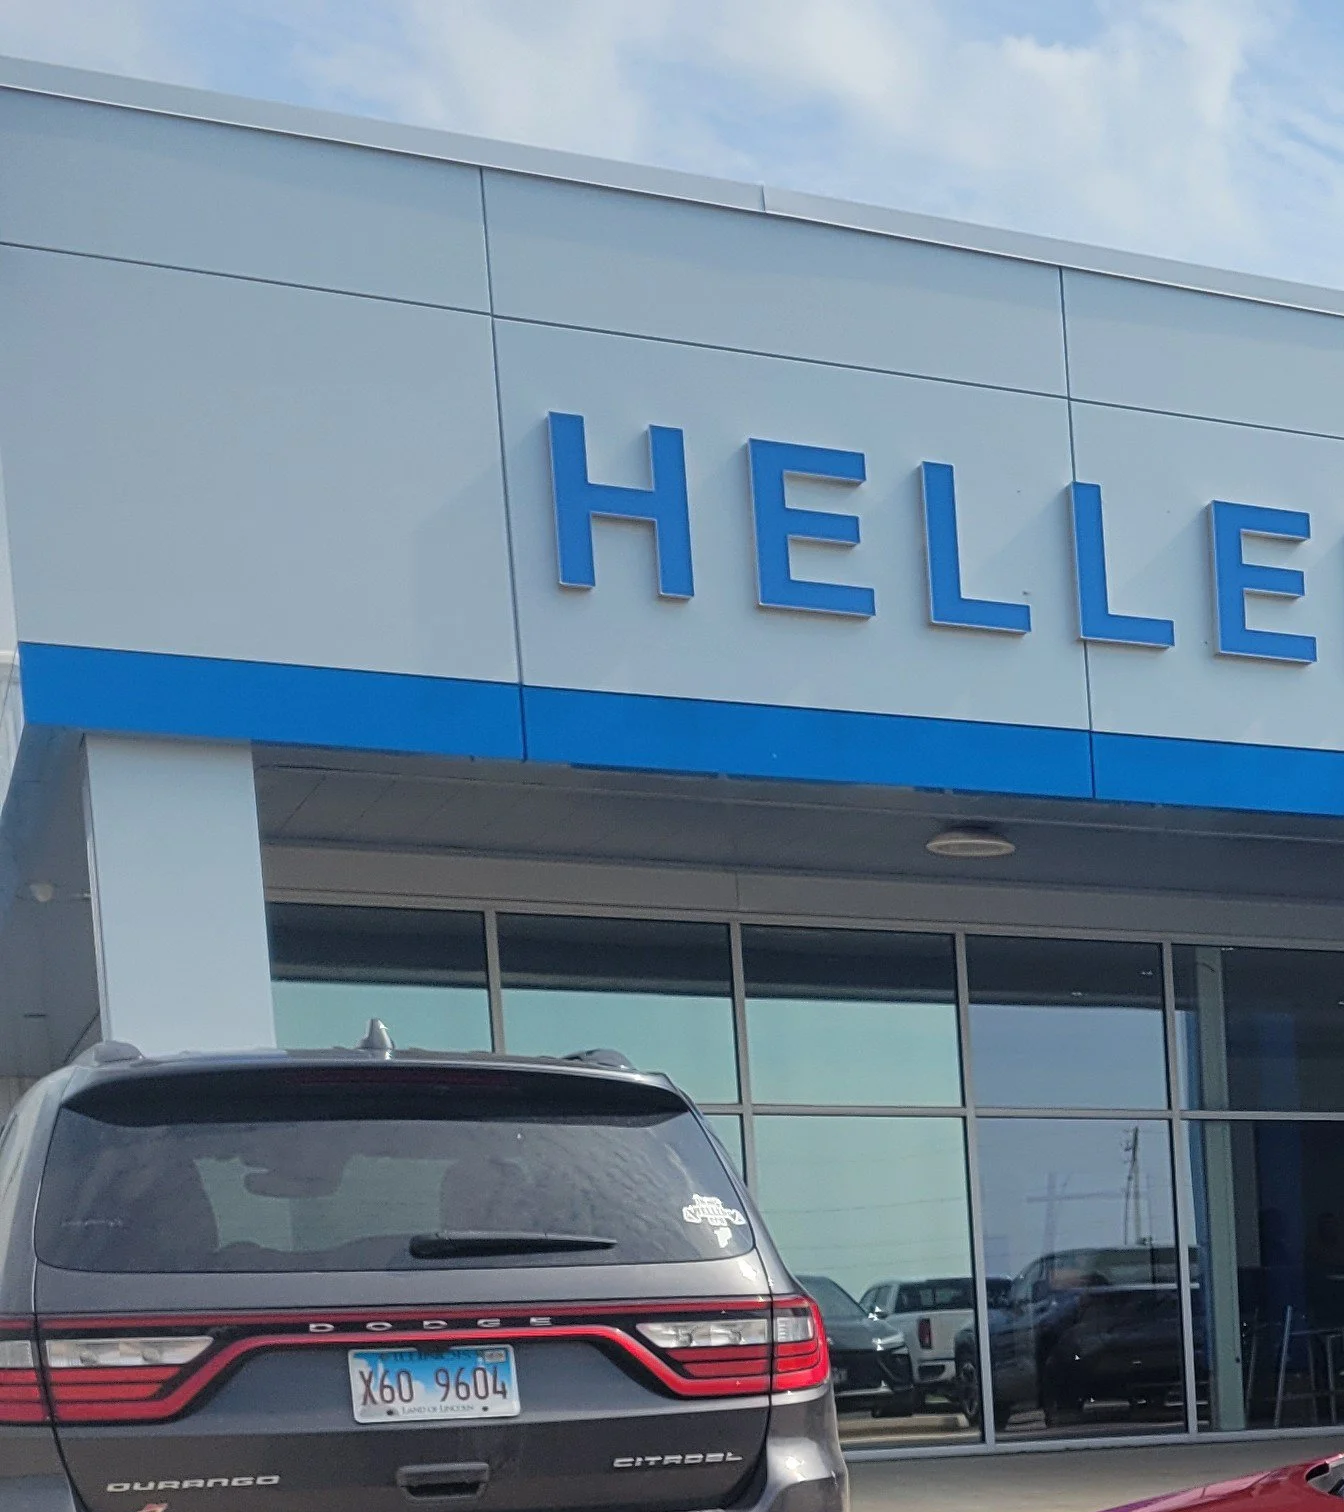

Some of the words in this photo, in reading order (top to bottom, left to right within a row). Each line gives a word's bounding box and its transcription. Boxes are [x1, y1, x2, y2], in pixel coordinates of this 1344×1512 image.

[309, 1317, 552, 1333] DODGE
[359, 1368, 414, 1406] X60
[434, 1367, 507, 1402] 9604
[613, 1452, 744, 1468] CITADEL
[106, 1475, 281, 1493] DURANGO
